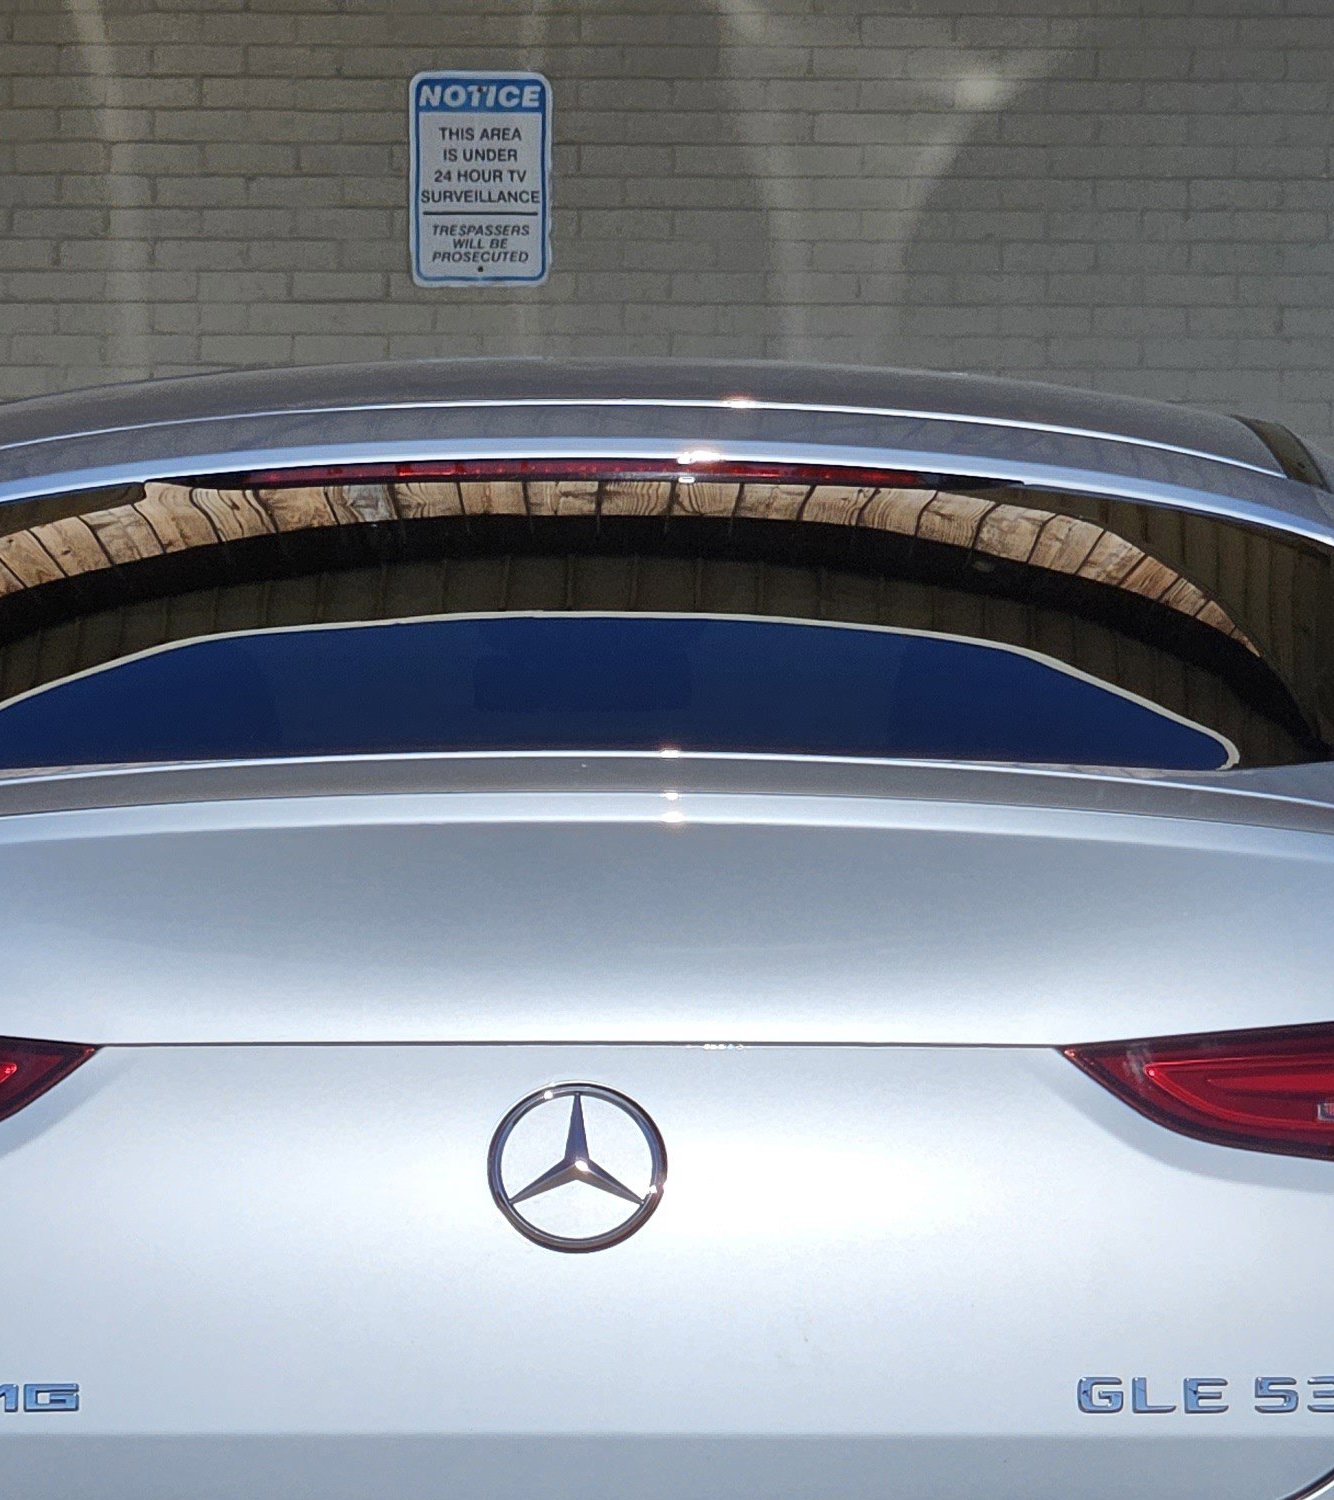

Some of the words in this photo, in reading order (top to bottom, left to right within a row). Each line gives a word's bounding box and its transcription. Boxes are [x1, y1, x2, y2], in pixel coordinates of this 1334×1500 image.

[419, 85, 541, 108] NOTICE
[439, 127, 475, 141] THIS
[480, 128, 522, 141] AREA
[443, 149, 457, 162] IS
[463, 149, 517, 162] UNDER
[434, 170, 451, 182] 24
[457, 170, 503, 182] HOUR
[508, 170, 526, 182] TV
[421, 191, 540, 204] SURVEILLANCE
[433, 225, 530, 236] TRESPASSERS
[453, 238, 484, 249] WILL
[489, 239, 507, 249] BE
[432, 252, 529, 263] PROSECUTED
[1077, 1376, 1229, 1414] GLE
